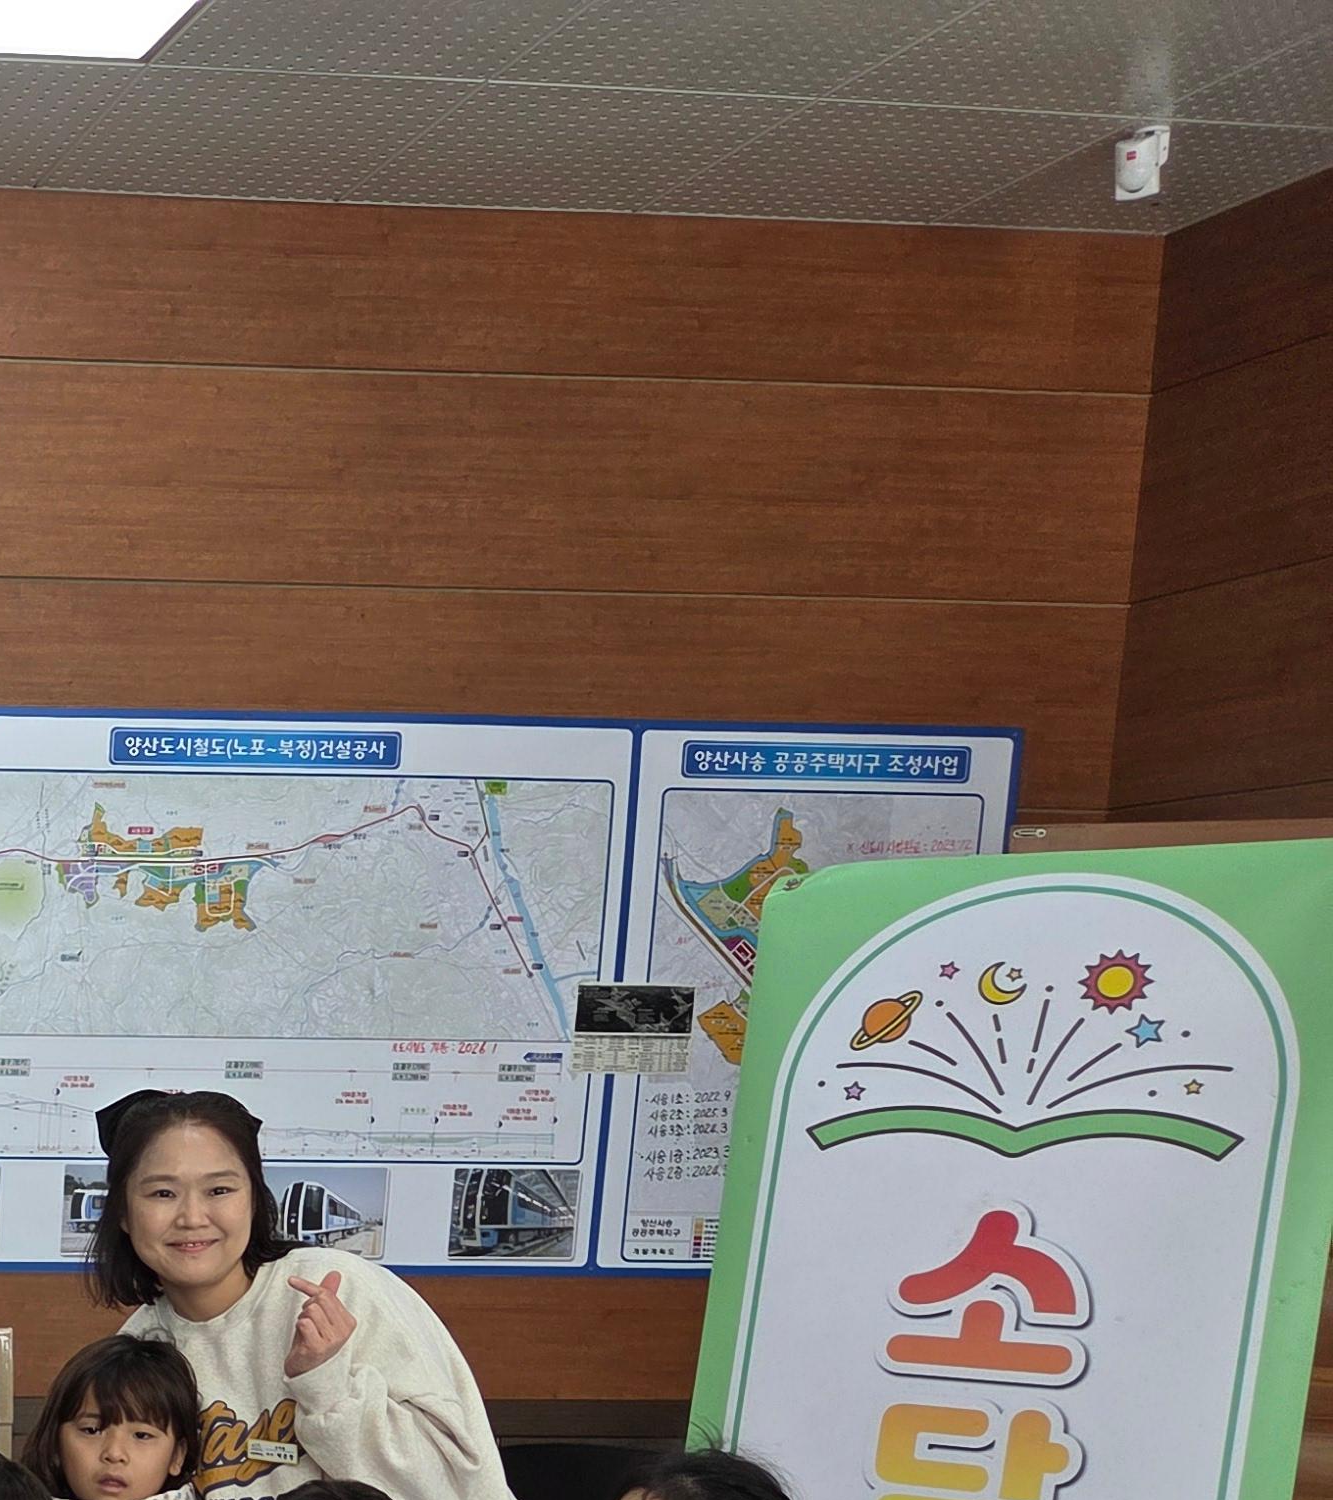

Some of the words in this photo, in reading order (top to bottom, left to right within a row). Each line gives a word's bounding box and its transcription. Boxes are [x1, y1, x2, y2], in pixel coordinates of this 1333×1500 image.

[124, 735, 387, 761] 양산도시철도(노포~북정)건설공사
[693, 749, 767, 773] 양산사송
[773, 751, 882, 775] 공공주택지구
[886, 754, 960, 777] 조성사업
